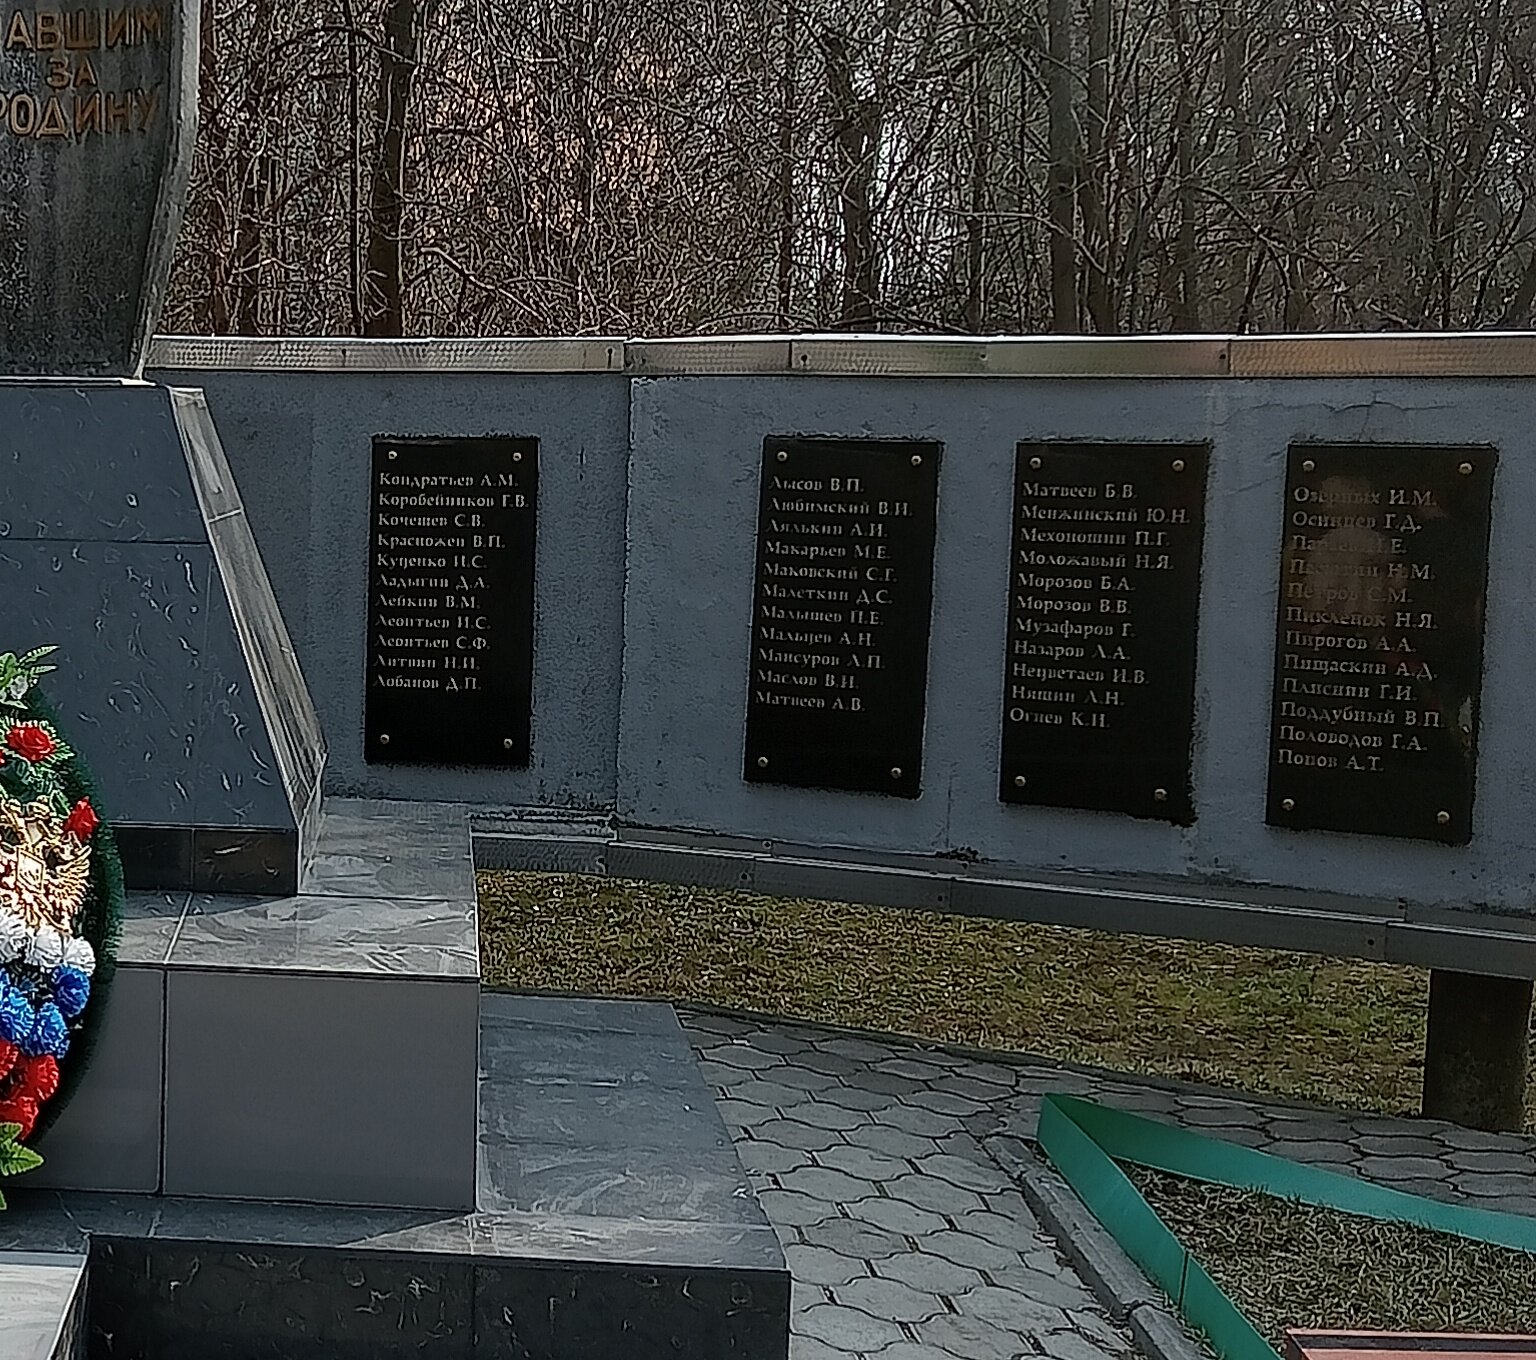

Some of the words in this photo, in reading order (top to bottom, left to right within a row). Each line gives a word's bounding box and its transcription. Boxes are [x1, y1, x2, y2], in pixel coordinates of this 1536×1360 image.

[46, 57, 97, 88] ЗА
[379, 472, 473, 489] Кондратьев
[768, 476, 823, 491] Лысов
[1022, 482, 1096, 497] Матвеев
[379, 493, 494, 509] Коробейников
[1021, 505, 1138, 522] Менжинский
[764, 541, 846, 560] Макарьев
[1018, 550, 1126, 568] Моложавый
[377, 554, 446, 571] Куценко
[763, 562, 858, 580] Маковский
[1017, 573, 1092, 592] Морозов
[761, 605, 842, 622] Малышев
[1016, 596, 1092, 614] Морозов
[374, 614, 449, 628] Леонтьев
[1016, 618, 1113, 639] Музафаров
[760, 626, 832, 645] Мальцев
[1286, 630, 1367, 651] Пирогов
[759, 648, 840, 668] Мансуров
[1014, 640, 1084, 660] Назаров
[372, 674, 439, 689] Лобанов
[757, 669, 817, 686] Маслов
[1009, 707, 1063, 725] Огнев
[1281, 701, 1396, 724] Поддубный
[1280, 725, 1382, 748] Половодов
[1278, 748, 1338, 768] Попов
